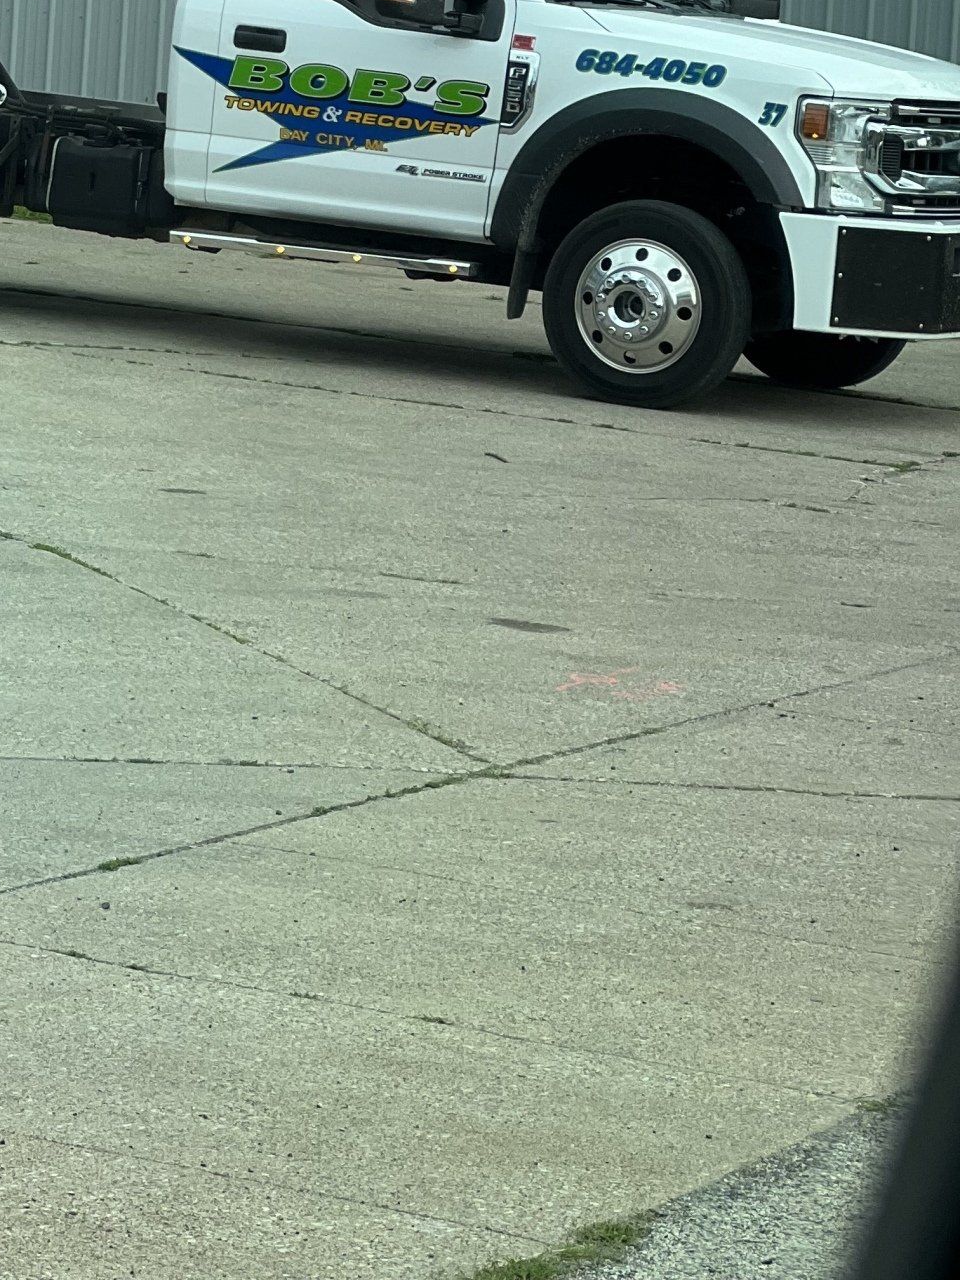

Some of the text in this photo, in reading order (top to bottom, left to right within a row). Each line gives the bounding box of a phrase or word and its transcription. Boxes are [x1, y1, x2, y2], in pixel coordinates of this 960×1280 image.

[227, 54, 491, 117] BOB'S
[575, 48, 728, 89] 684-4050
[224, 95, 483, 138] TOWING & RECOVERY
[280, 127, 310, 141] BAY
[757, 101, 789, 128] 37
